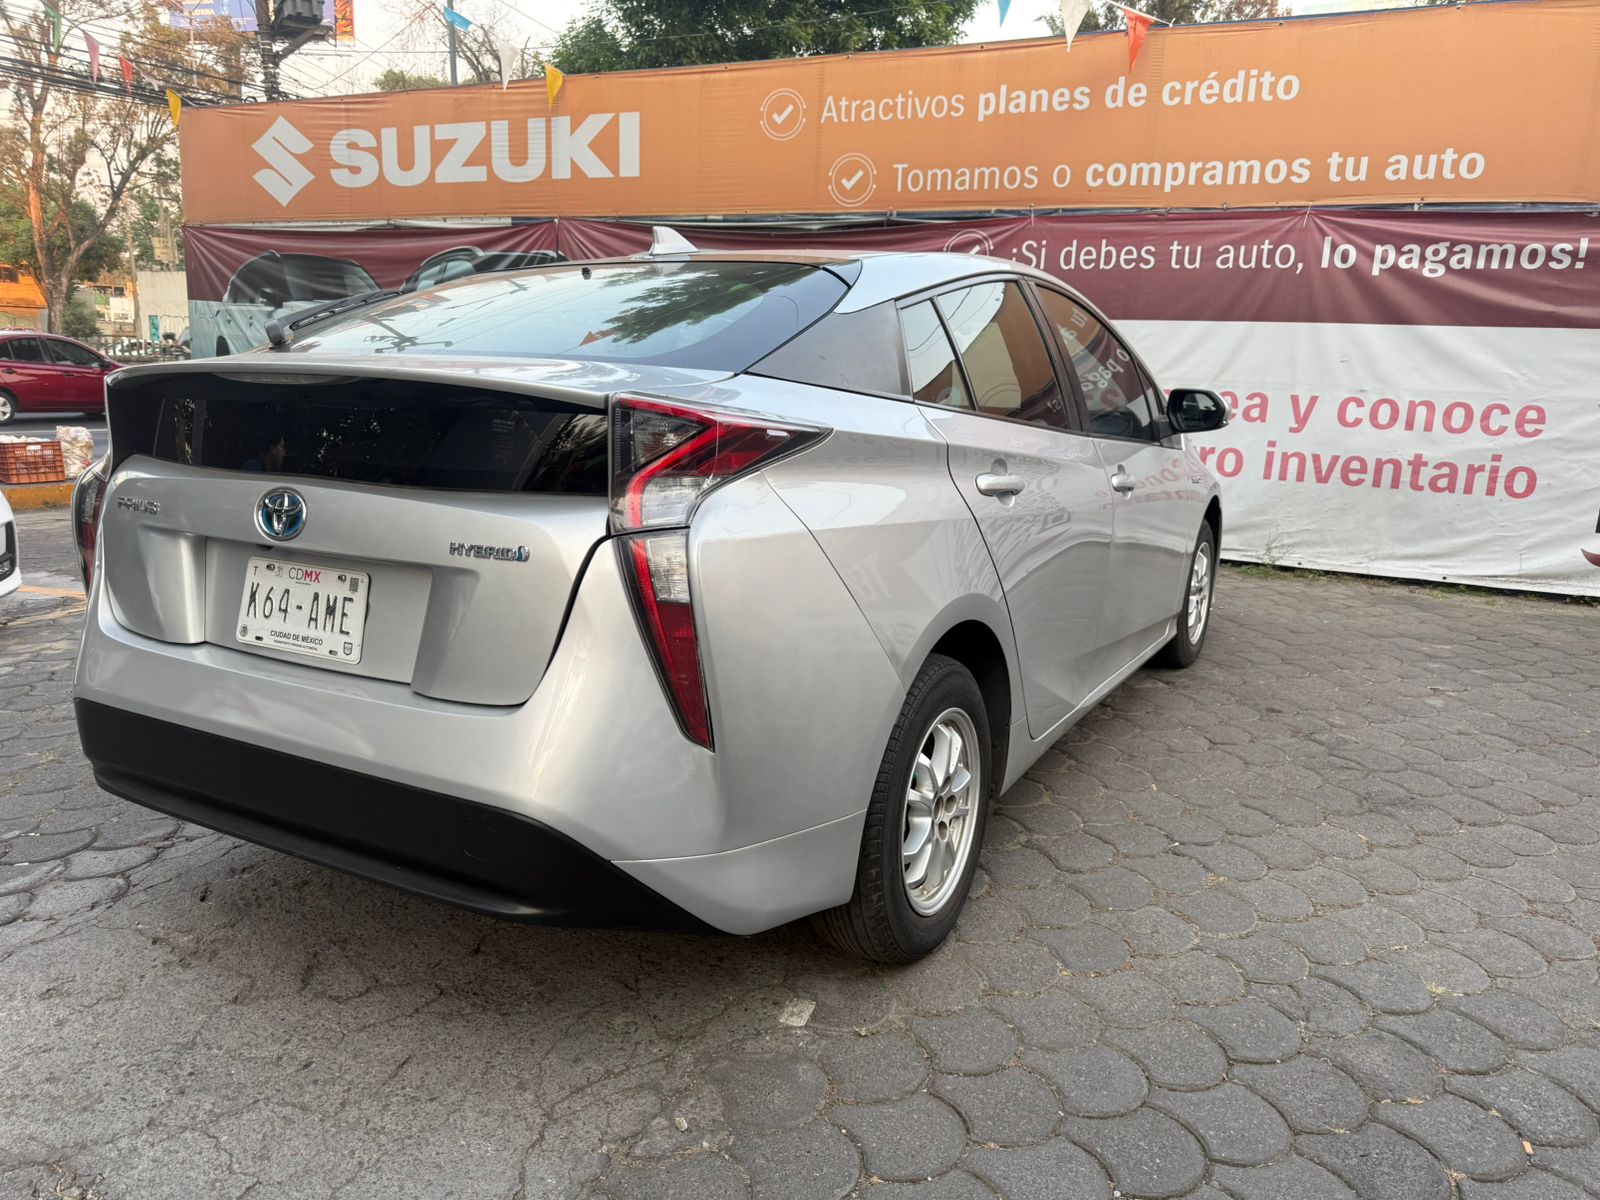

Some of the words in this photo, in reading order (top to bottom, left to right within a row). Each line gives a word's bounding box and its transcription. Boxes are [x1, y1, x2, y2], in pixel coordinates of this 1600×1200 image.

[820, 92, 965, 124] Atractivos
[977, 84, 1091, 121] planes
[1105, 76, 1148, 108] de
[1162, 70, 1300, 106] crédito
[329, 111, 641, 189] SUZUKI
[893, 161, 1039, 193] Tomamos
[1053, 162, 1072, 188] o
[1086, 156, 1312, 193] compramos
[1327, 151, 1369, 183] tu
[1384, 147, 1486, 181] auto
[1059, 239, 1157, 270] debes
[1169, 240, 1202, 270] tu
[1215, 239, 1305, 274] auto,
[1320, 235, 1357, 269] lo
[1371, 237, 1589, 278] pagamos!
[1288, 394, 1320, 434] y
[1336, 396, 1547, 439] conoce
[1200, 440, 1244, 478] ro
[1262, 440, 1538, 499] inventario
[449, 541, 516, 561] HYBRID
[288, 566, 322, 584] CDMX
[246, 581, 355, 636] K64-AME
[270, 629, 292, 641] CIUDAD
[292, 633, 301, 642] DE
[301, 634, 324, 647] MÉXICO
